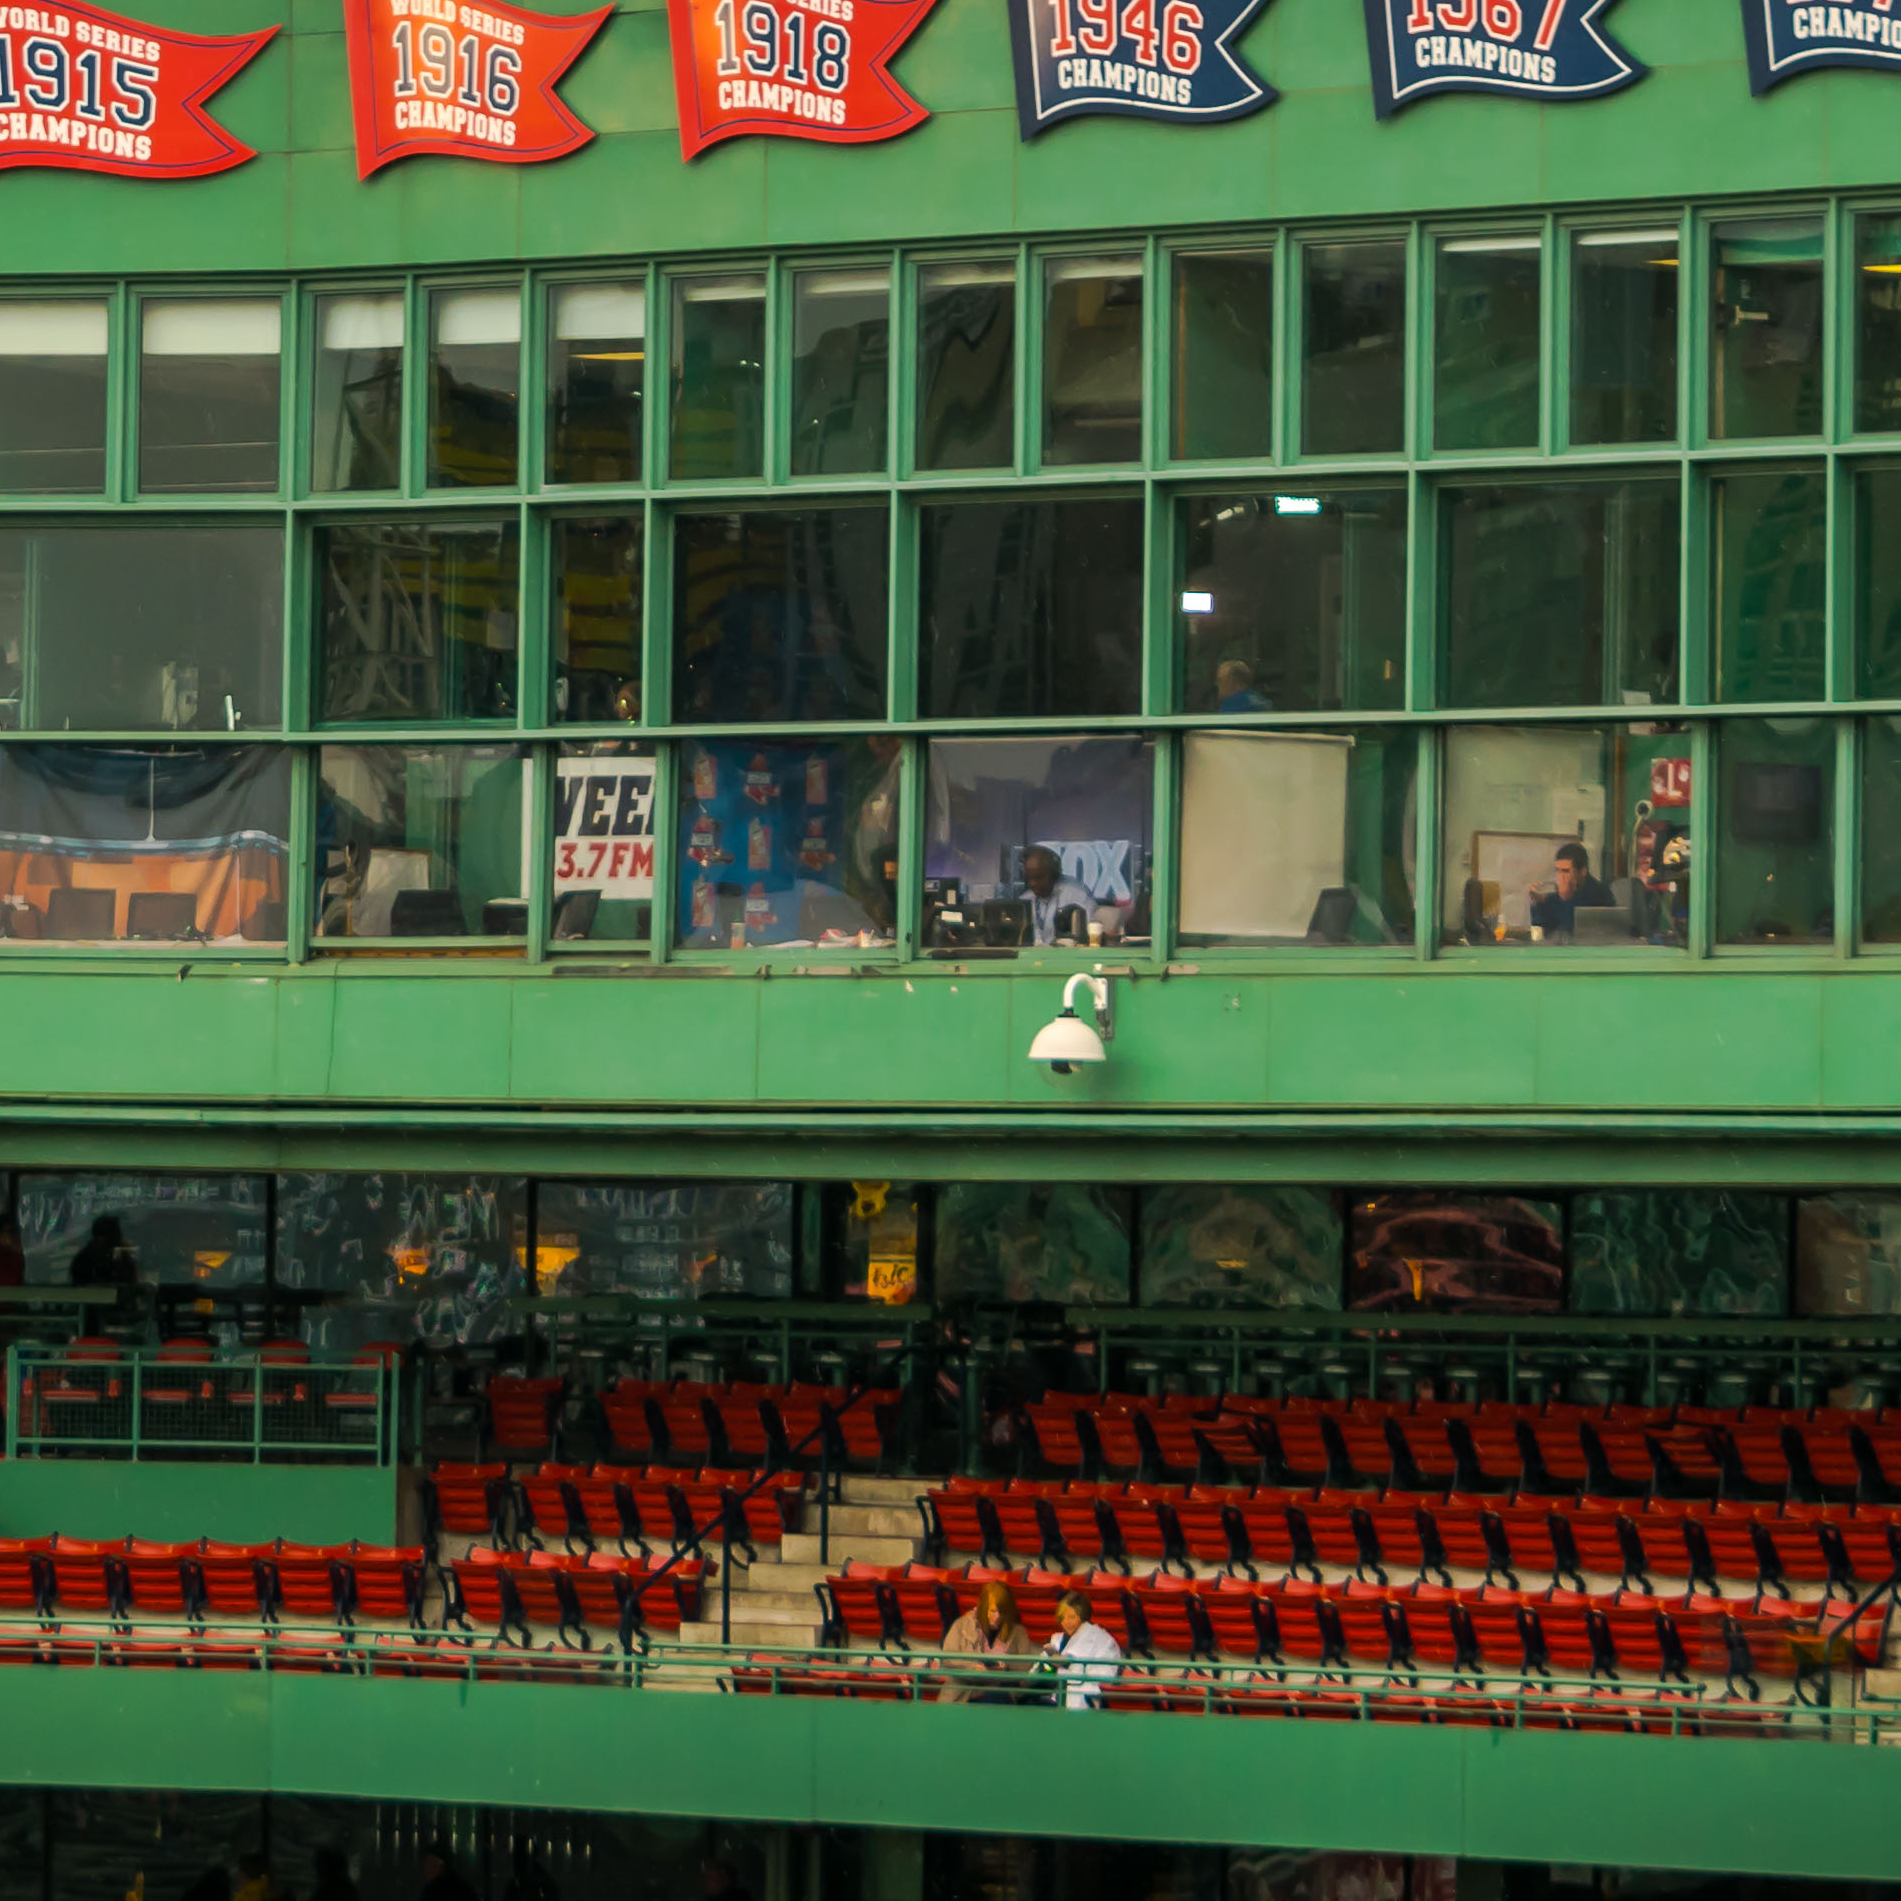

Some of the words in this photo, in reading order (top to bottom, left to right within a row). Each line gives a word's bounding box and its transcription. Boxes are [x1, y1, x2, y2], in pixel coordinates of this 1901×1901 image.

[75, 20, 161, 62] SERIES
[460, 5, 525, 46] SERIES
[392, 21, 522, 116] 1916
[1057, 58, 1191, 104] CHAMPIONS
[1414, 36, 1556, 84] CHAMPIONS
[394, 101, 516, 146] CHAMPIONS
[718, 80, 846, 125] CHAMPIONS
